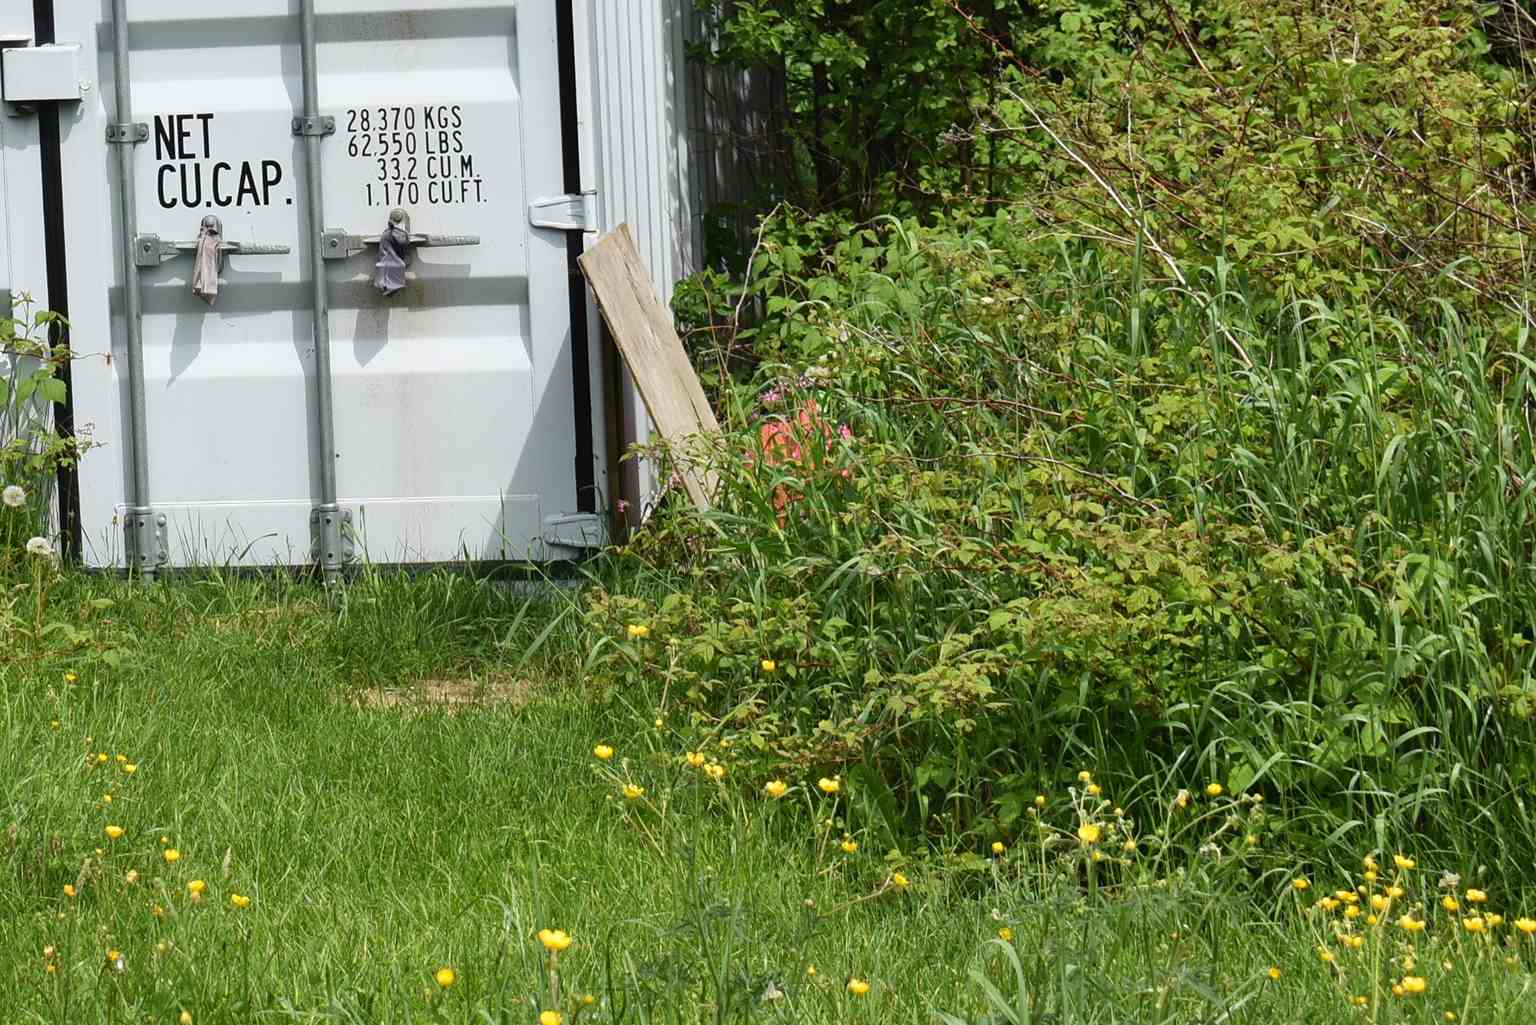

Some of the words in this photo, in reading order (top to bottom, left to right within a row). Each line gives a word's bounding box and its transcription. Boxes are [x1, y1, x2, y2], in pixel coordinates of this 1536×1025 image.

[423, 105, 462, 130] KGS
[153, 113, 214, 161] NET
[425, 129, 464, 155] LBS
[376, 156, 419, 182] 33.2
[426, 154, 481, 180] CU.M.
[157, 159, 292, 209] CU.CAP.
[428, 178, 488, 205] CU.FT.
